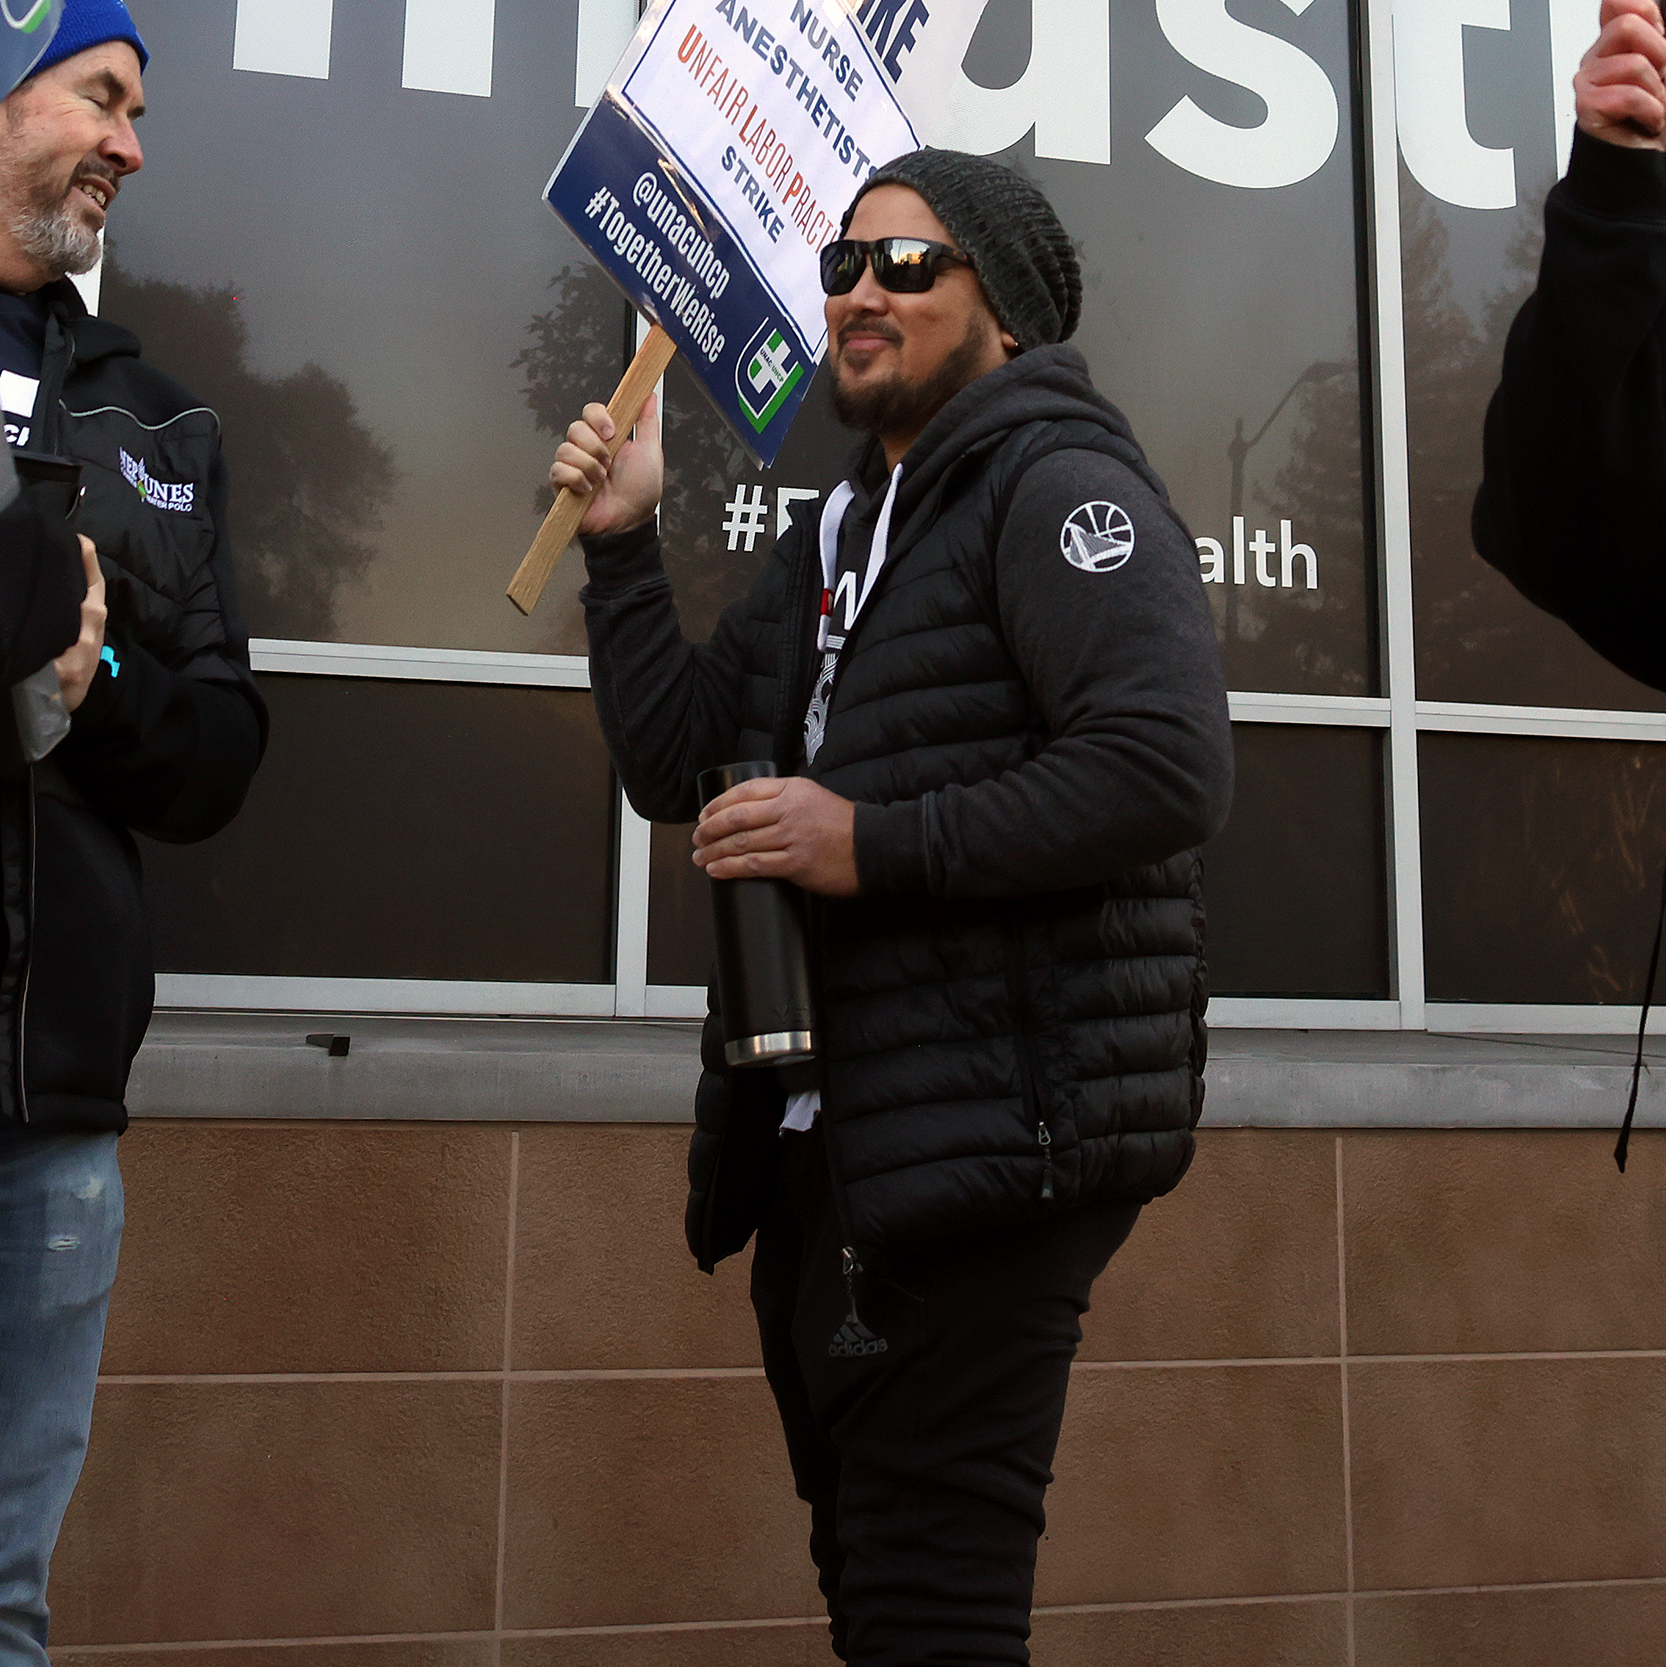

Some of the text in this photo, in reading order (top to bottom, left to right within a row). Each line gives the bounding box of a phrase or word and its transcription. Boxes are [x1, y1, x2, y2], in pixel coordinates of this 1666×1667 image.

[677, 23, 749, 126] UNFAIR
[737, 103, 794, 194] LABOR
[632, 171, 731, 300] @unacuhcp
[721, 145, 786, 244] STRIKE
[583, 185, 726, 364] #TogetherWeRise
[828, 1338, 888, 1357] adidas
